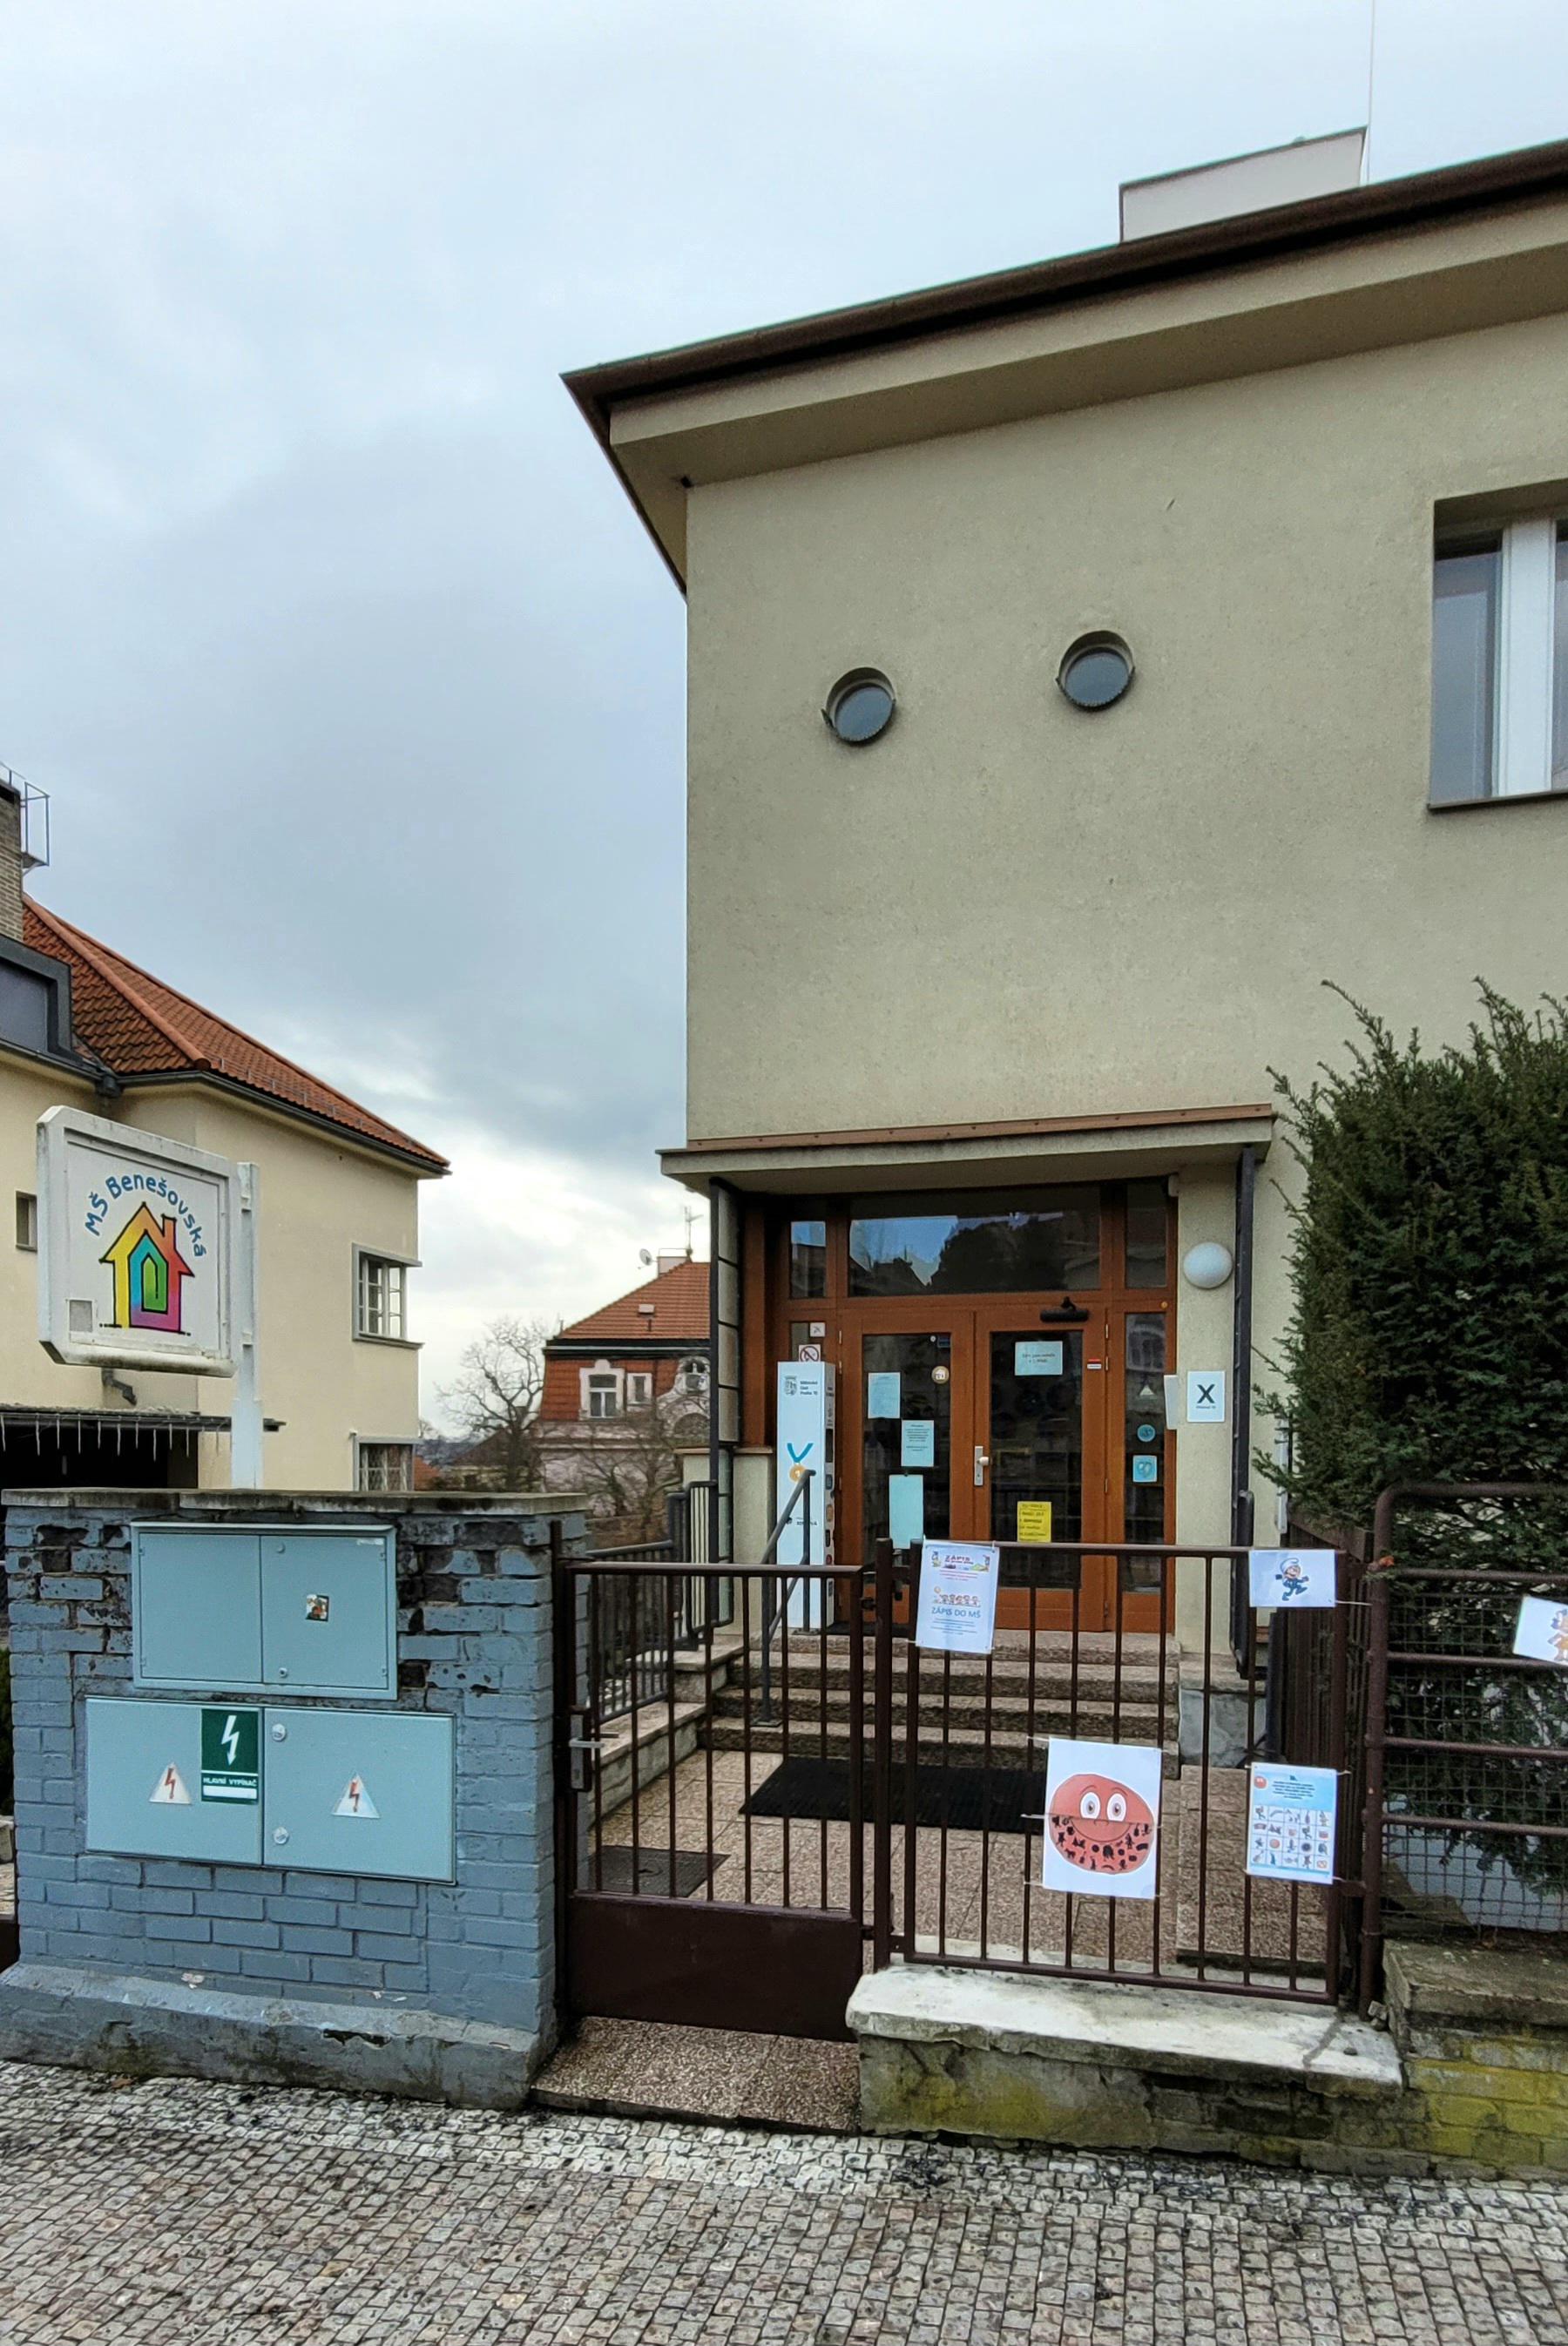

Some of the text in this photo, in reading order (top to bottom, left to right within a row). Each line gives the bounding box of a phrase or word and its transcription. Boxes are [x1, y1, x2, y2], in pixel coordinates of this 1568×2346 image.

[84, 1173, 207, 1257] MŠ Benešovská
[931, 1606, 982, 1619] ZÁPIS DO MŠ
[228, 1778, 258, 1787] VYPÍNAČ
